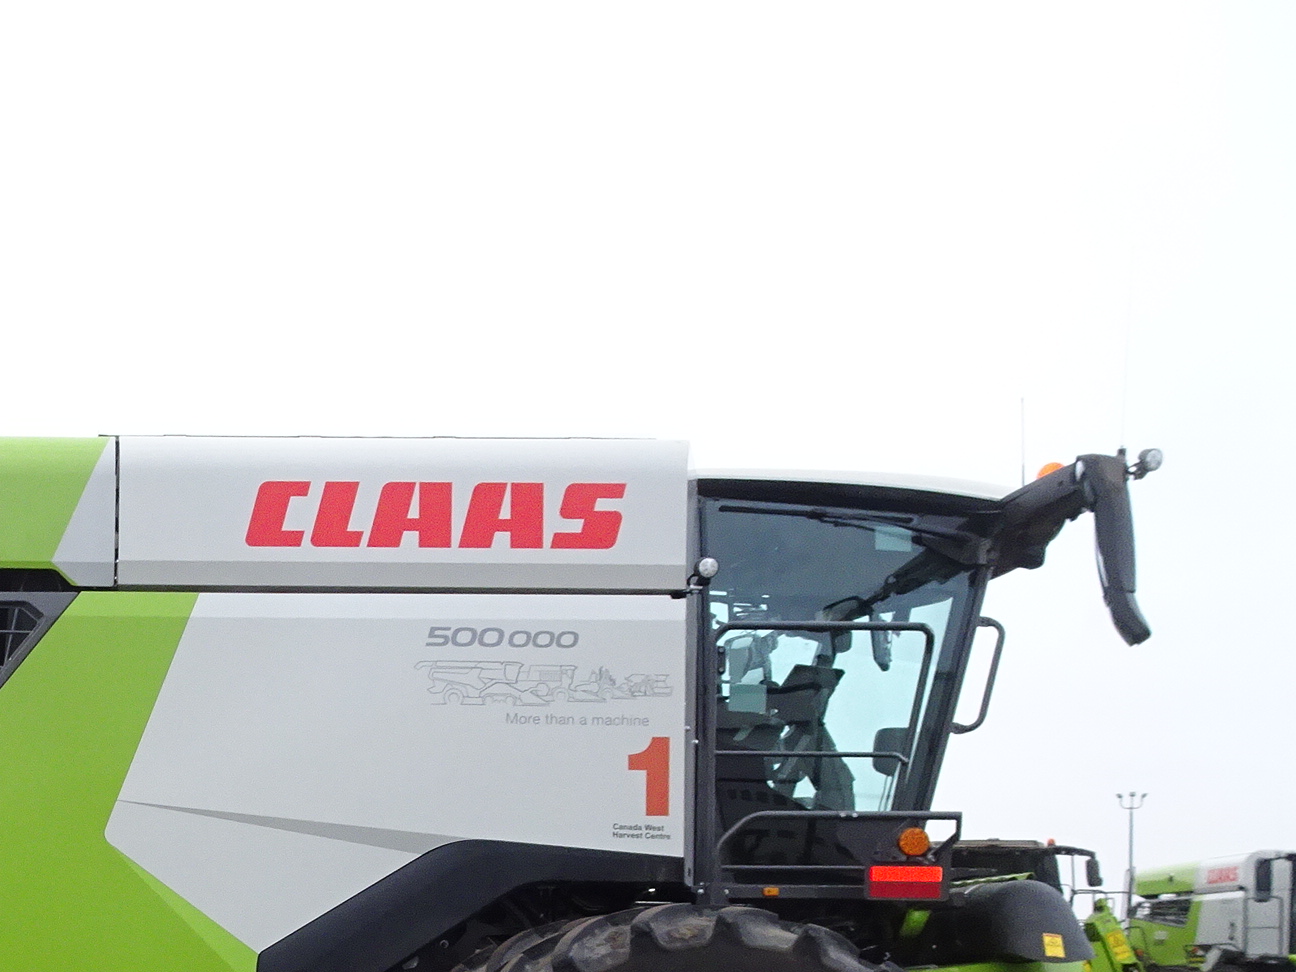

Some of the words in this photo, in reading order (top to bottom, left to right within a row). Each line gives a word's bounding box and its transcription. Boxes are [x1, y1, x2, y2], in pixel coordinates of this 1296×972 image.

[245, 481, 627, 549] CLAAS
[505, 712, 541, 725] More
[544, 713, 575, 726] than
[579, 717, 588, 726] a
[591, 714, 650, 727] machine
[628, 736, 670, 817] 1
[612, 822, 643, 832] Canada
[644, 823, 665, 832] West
[612, 831, 644, 840] Harvest
[644, 832, 671, 840] Centre
